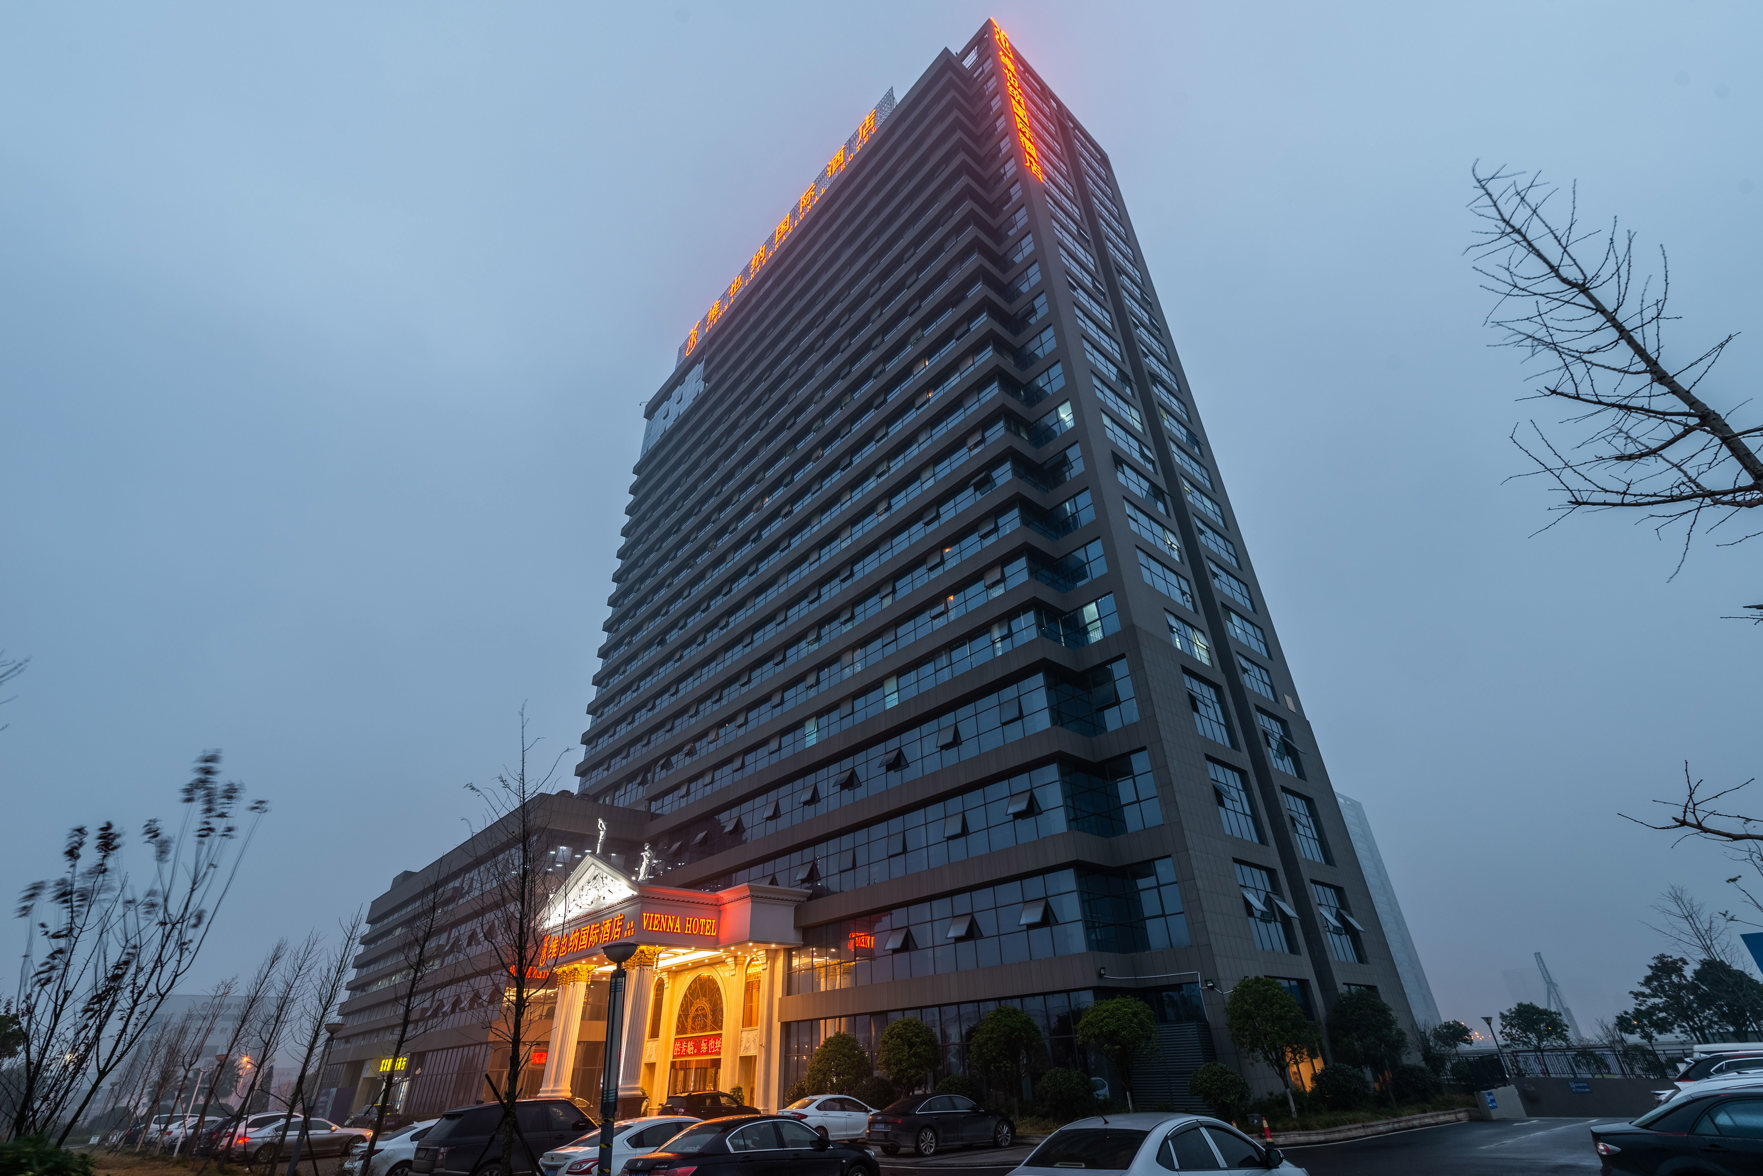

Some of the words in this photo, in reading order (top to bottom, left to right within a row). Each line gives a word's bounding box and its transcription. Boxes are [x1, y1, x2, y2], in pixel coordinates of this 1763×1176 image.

[706, 108, 878, 326] 维也纳国际酒店
[744, 186, 826, 287] INTERNATIONAL
[840, 126, 878, 173] HOTEL
[547, 913, 626, 961] 维也纳国际酒店
[642, 912, 681, 934] VIENNA
[684, 917, 718, 937] HOTEL
